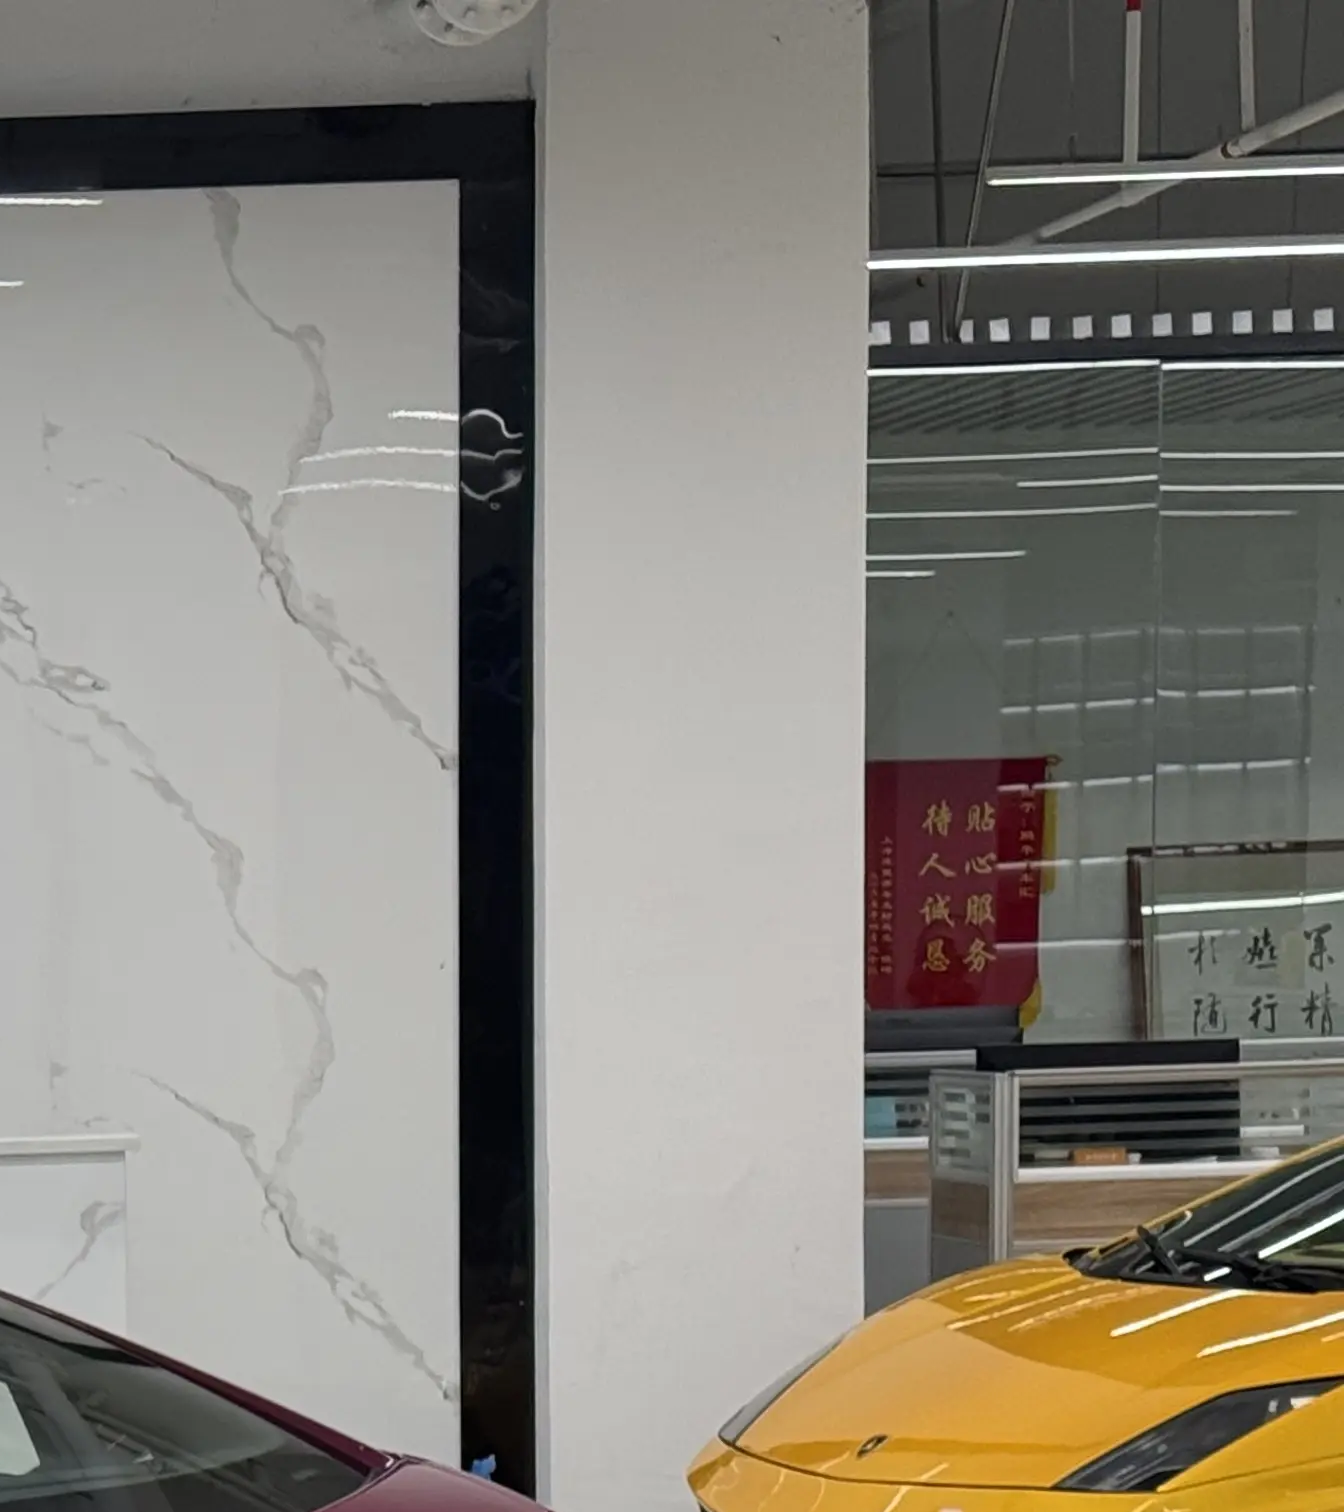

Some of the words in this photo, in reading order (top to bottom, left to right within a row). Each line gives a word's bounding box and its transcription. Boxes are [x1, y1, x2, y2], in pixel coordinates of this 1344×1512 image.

[918, 799, 958, 973] 待人诚恳
[963, 801, 998, 973] 贴心服务
